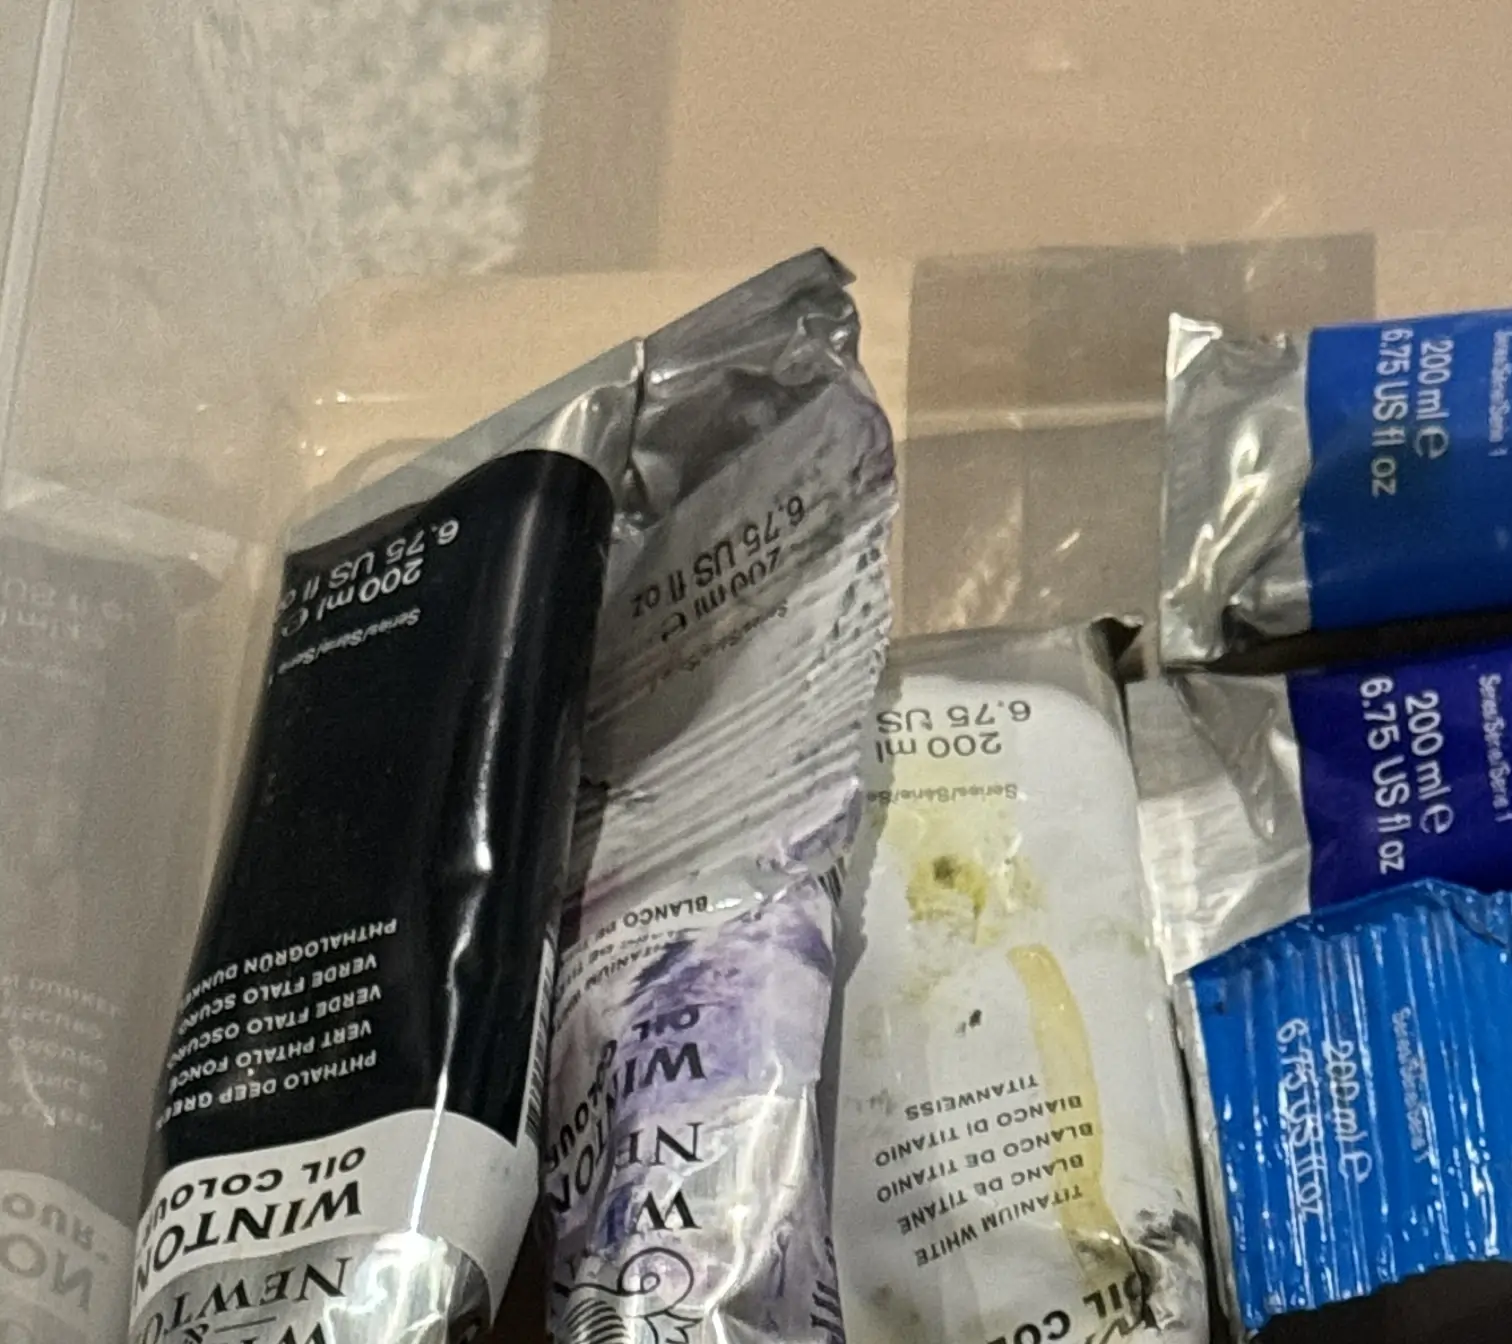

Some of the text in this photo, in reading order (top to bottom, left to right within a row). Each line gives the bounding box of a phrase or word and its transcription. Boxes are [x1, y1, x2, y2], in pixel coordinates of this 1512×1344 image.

[1415, 338, 1455, 420] 200 ml
[1370, 328, 1414, 499] 6.75 US oz
[327, 519, 461, 589] 6.75 US
[692, 540, 737, 594] US
[316, 557, 424, 621] 200 ml
[875, 699, 1033, 735] 6.75 US
[1405, 690, 1452, 802] 200 ml
[874, 730, 1003, 765] 200 ml
[1359, 675, 1411, 875] 6.75 US oz
[622, 895, 709, 929] BLANCO
[243, 917, 398, 977] PHTHALOGRÜN
[242, 952, 378, 1005] VERDE FTALO
[245, 983, 383, 1036] VERDE FTALO
[234, 1018, 373, 1069] VERT PHTALO
[1321, 1040, 1361, 1101] 200
[217, 1049, 378, 1105] PHTHALO DEEP
[902, 1074, 1040, 1122] TITANWEISS
[874, 1094, 1084, 1169] BIANCO DI TITANIO
[301, 1146, 368, 1185] OIL
[875, 1121, 1095, 1205] BLANCO DE TITANIO
[895, 1153, 1086, 1237] BLANC DE TITANE
[1299, 1181, 1324, 1222] oz
[912, 1183, 1085, 1268] TITANIUM WHITE
